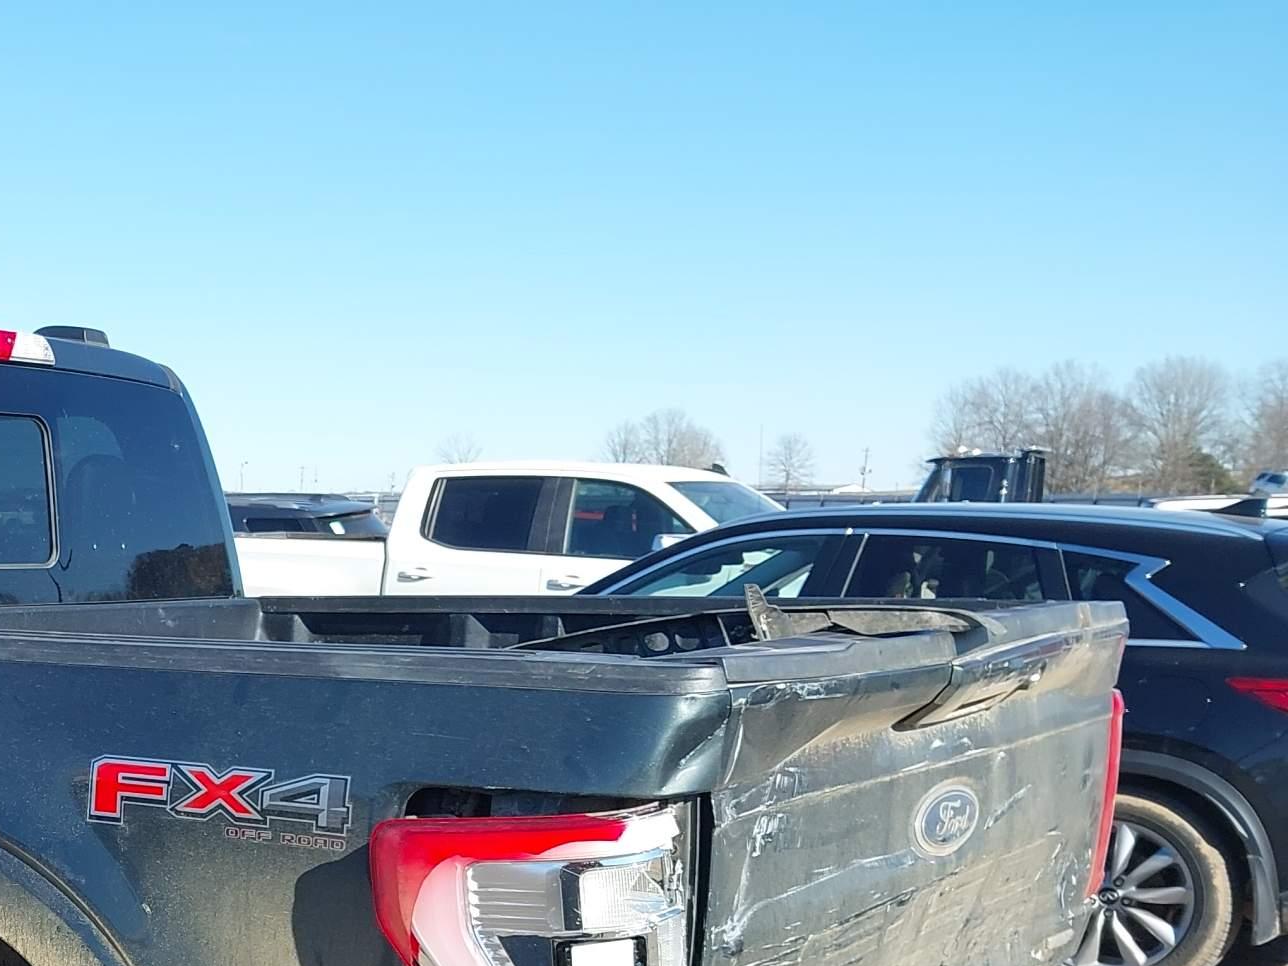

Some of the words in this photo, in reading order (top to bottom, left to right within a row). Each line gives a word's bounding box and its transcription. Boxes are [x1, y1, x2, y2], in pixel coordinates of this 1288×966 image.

[87, 754, 353, 837] FX4
[935, 799, 970, 837] Ford
[224, 826, 273, 842] OFF
[279, 831, 347, 851] ROAD
